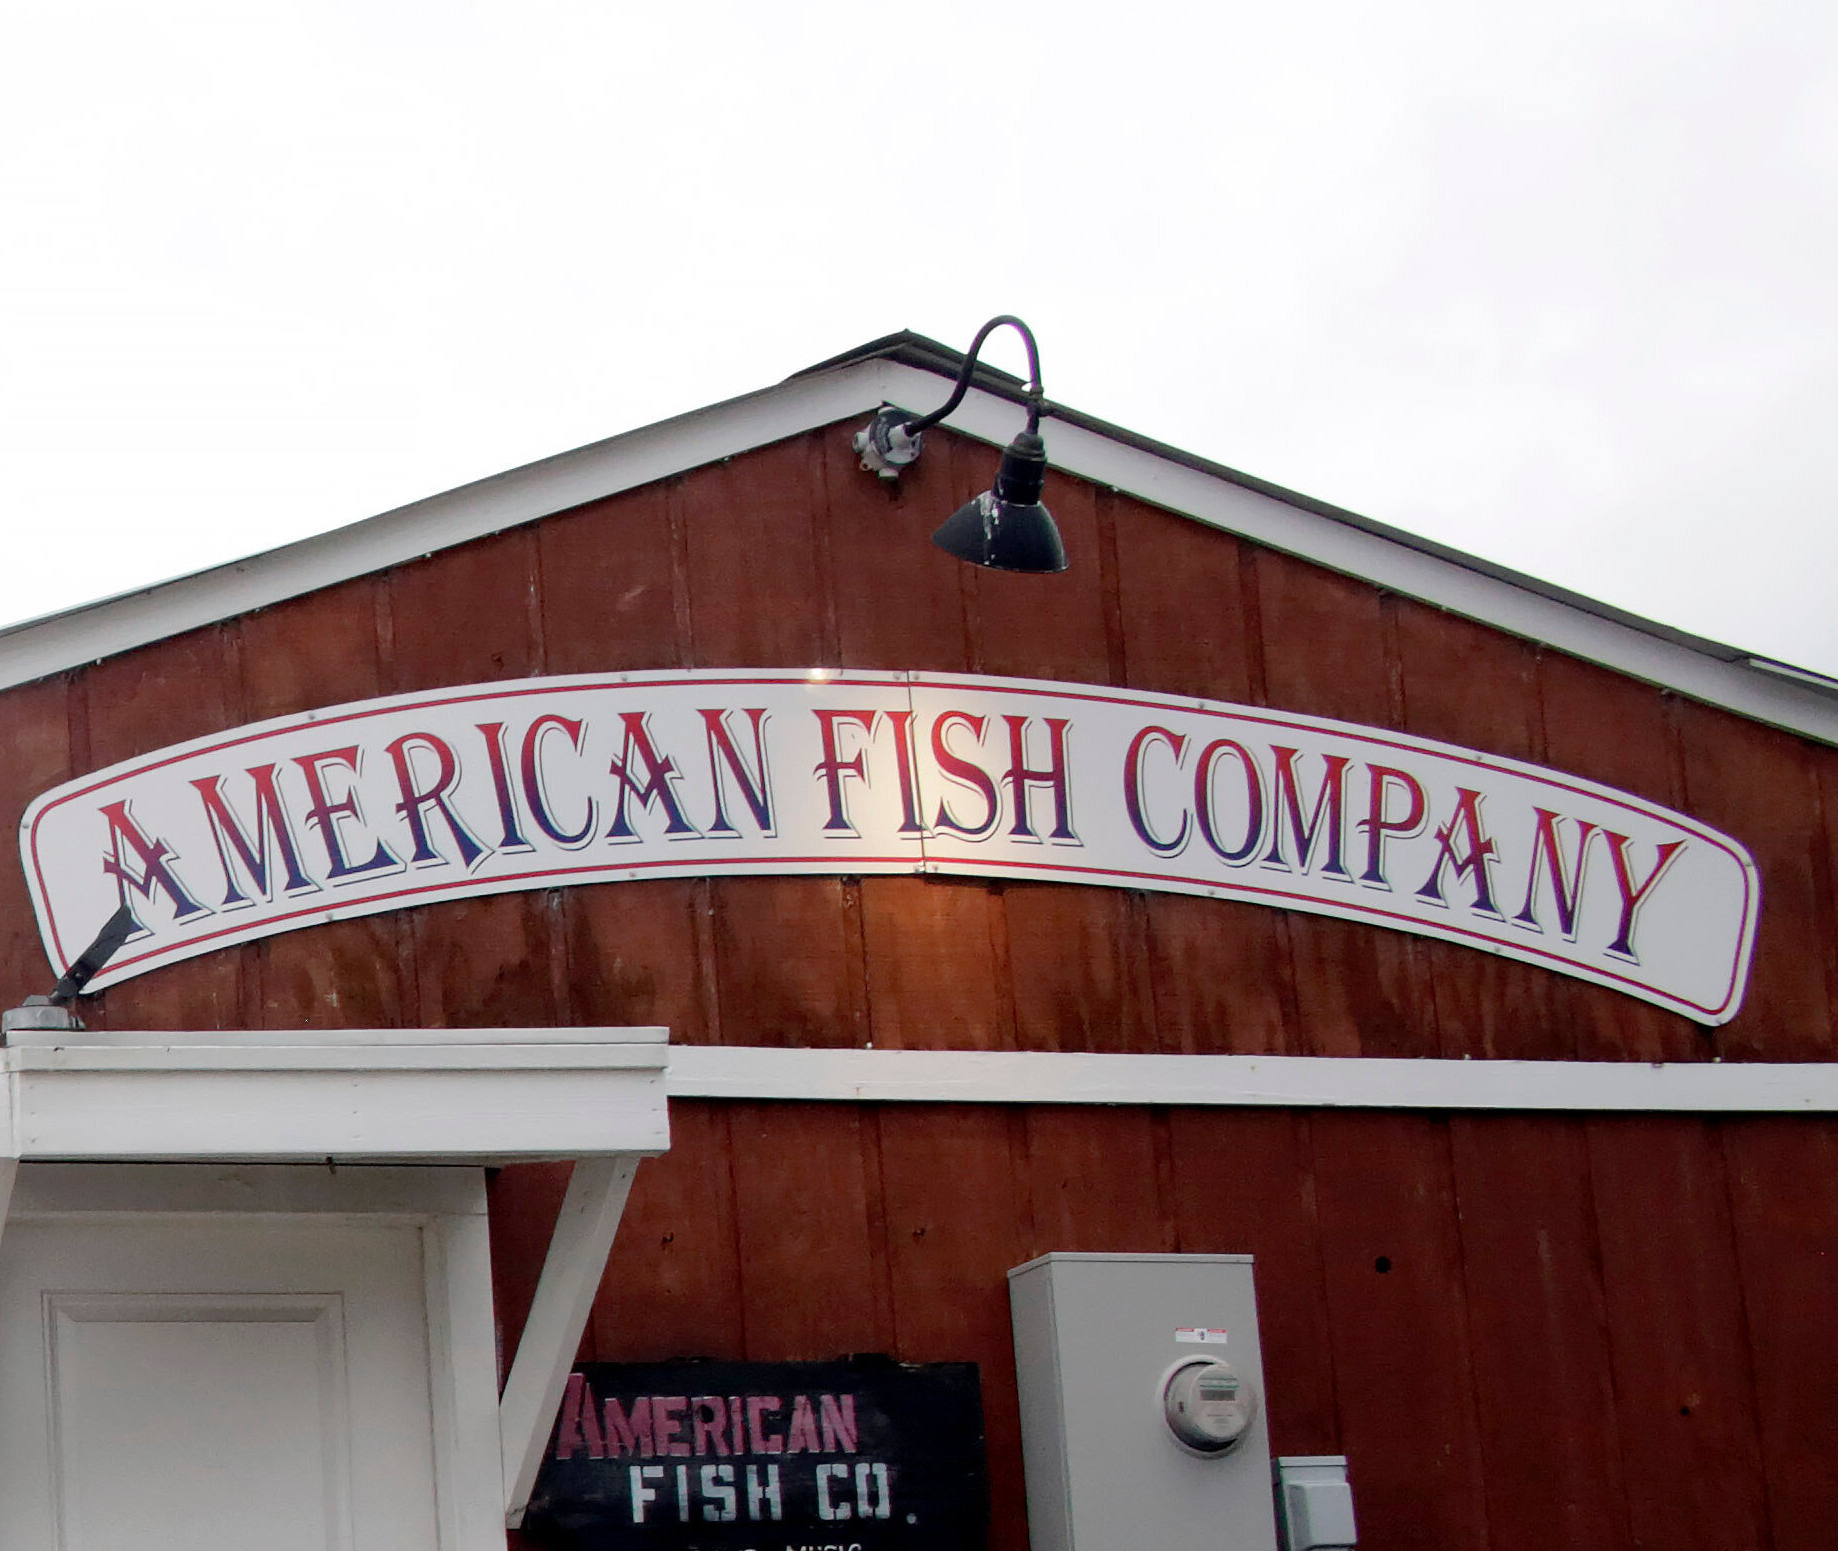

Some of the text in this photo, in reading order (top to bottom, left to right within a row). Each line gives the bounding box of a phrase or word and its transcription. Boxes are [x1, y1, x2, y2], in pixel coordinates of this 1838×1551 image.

[98, 707, 1688, 966] AMERICAN FISH COMPANY
[556, 1373, 859, 1460] AMERICAN
[629, 1462, 918, 1524] FISH CO.
